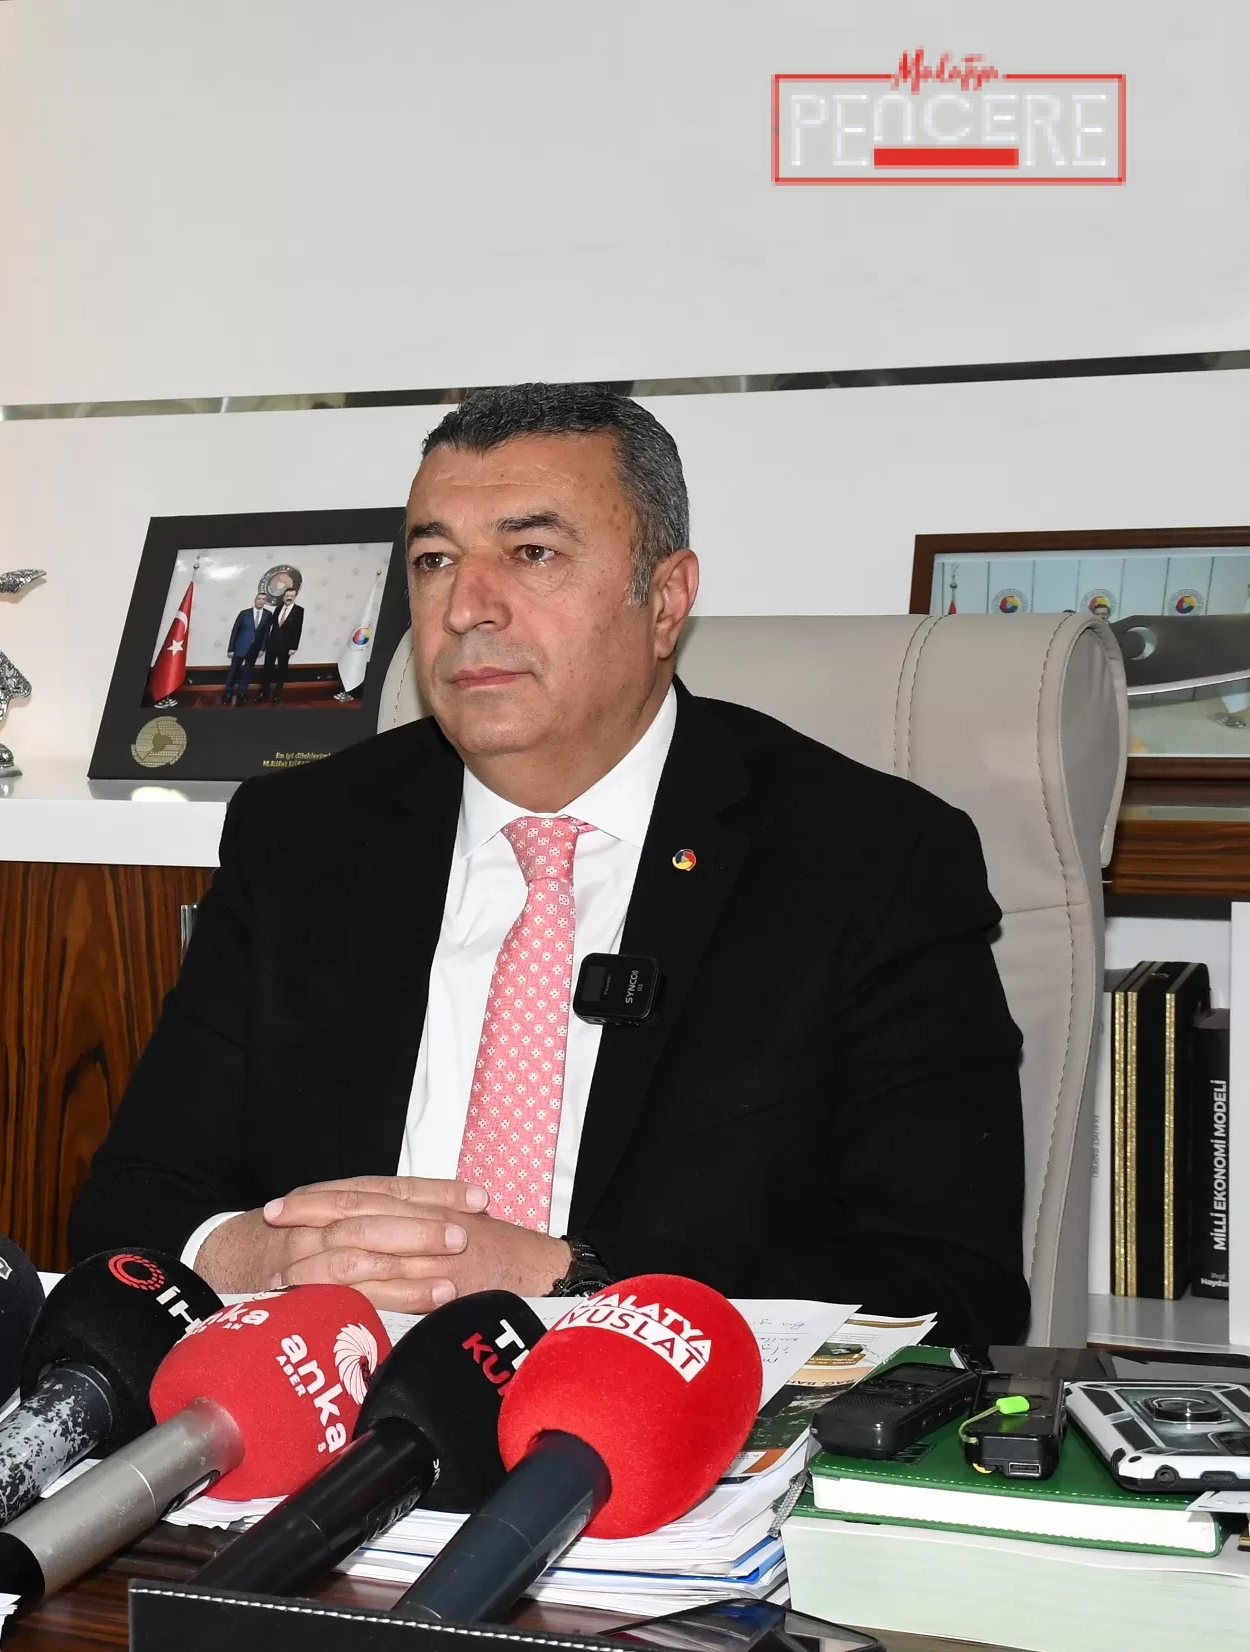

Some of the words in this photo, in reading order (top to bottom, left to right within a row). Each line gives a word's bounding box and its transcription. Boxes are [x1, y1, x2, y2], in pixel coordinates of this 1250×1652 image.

[1210, 1079, 1227, 1137] MODELİ
[1210, 1139, 1227, 1211] EKONOMİ
[1210, 1212, 1227, 1251] MİLLİ
[176, 1303, 270, 1346] nka
[567, 1308, 701, 1370] VUSLAT
[579, 1292, 712, 1363] MALATYA
[281, 1334, 347, 1453] anka
